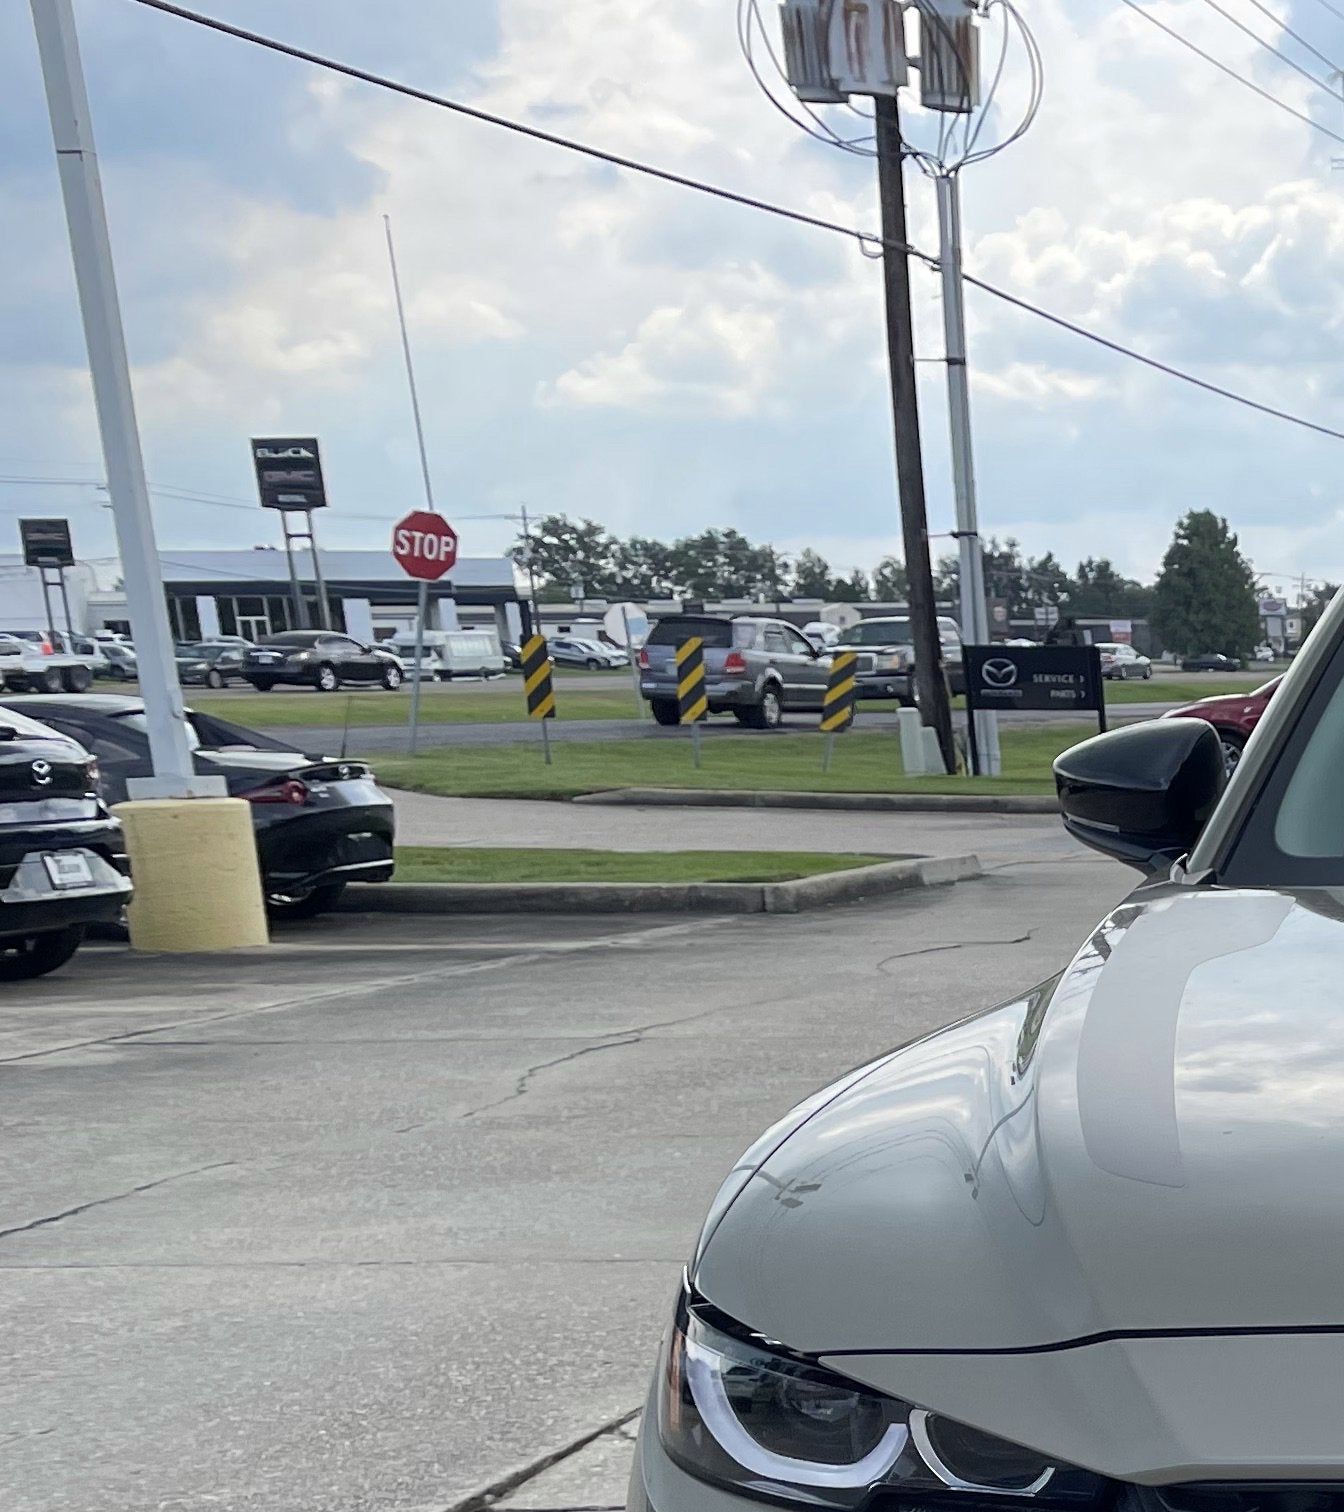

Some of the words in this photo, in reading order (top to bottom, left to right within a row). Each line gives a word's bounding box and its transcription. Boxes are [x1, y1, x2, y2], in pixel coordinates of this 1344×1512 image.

[396, 529, 455, 561] STOP
[1032, 673, 1075, 683] SERVICE
[1050, 689, 1077, 699] PARTS
